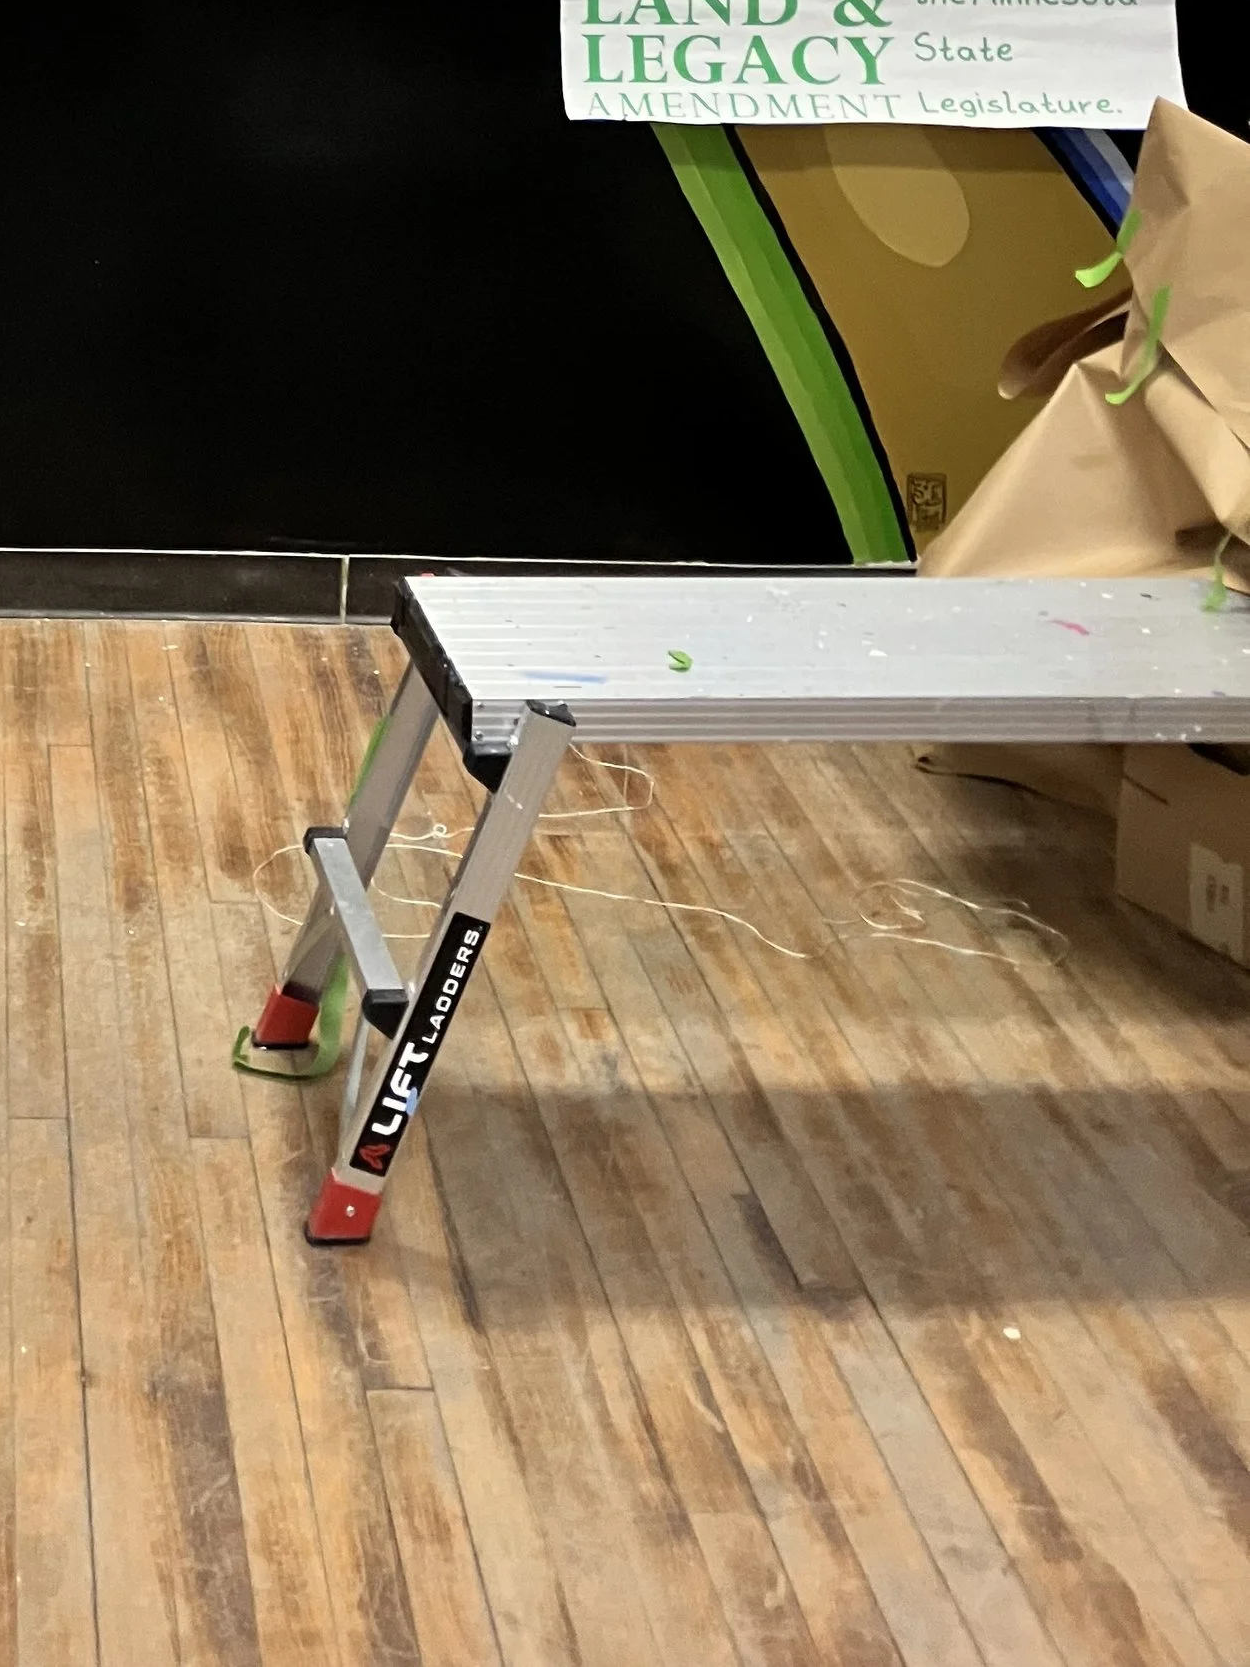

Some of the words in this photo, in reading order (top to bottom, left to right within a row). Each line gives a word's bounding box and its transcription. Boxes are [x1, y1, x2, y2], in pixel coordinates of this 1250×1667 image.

[582, 34, 895, 84] LEGACY
[914, 32, 1014, 62] State
[587, 92, 900, 119] AMENDMENT
[918, 91, 1123, 118] Legislature.
[372, 1042, 429, 1135] LIFT
[422, 929, 480, 1044] LADDERS
